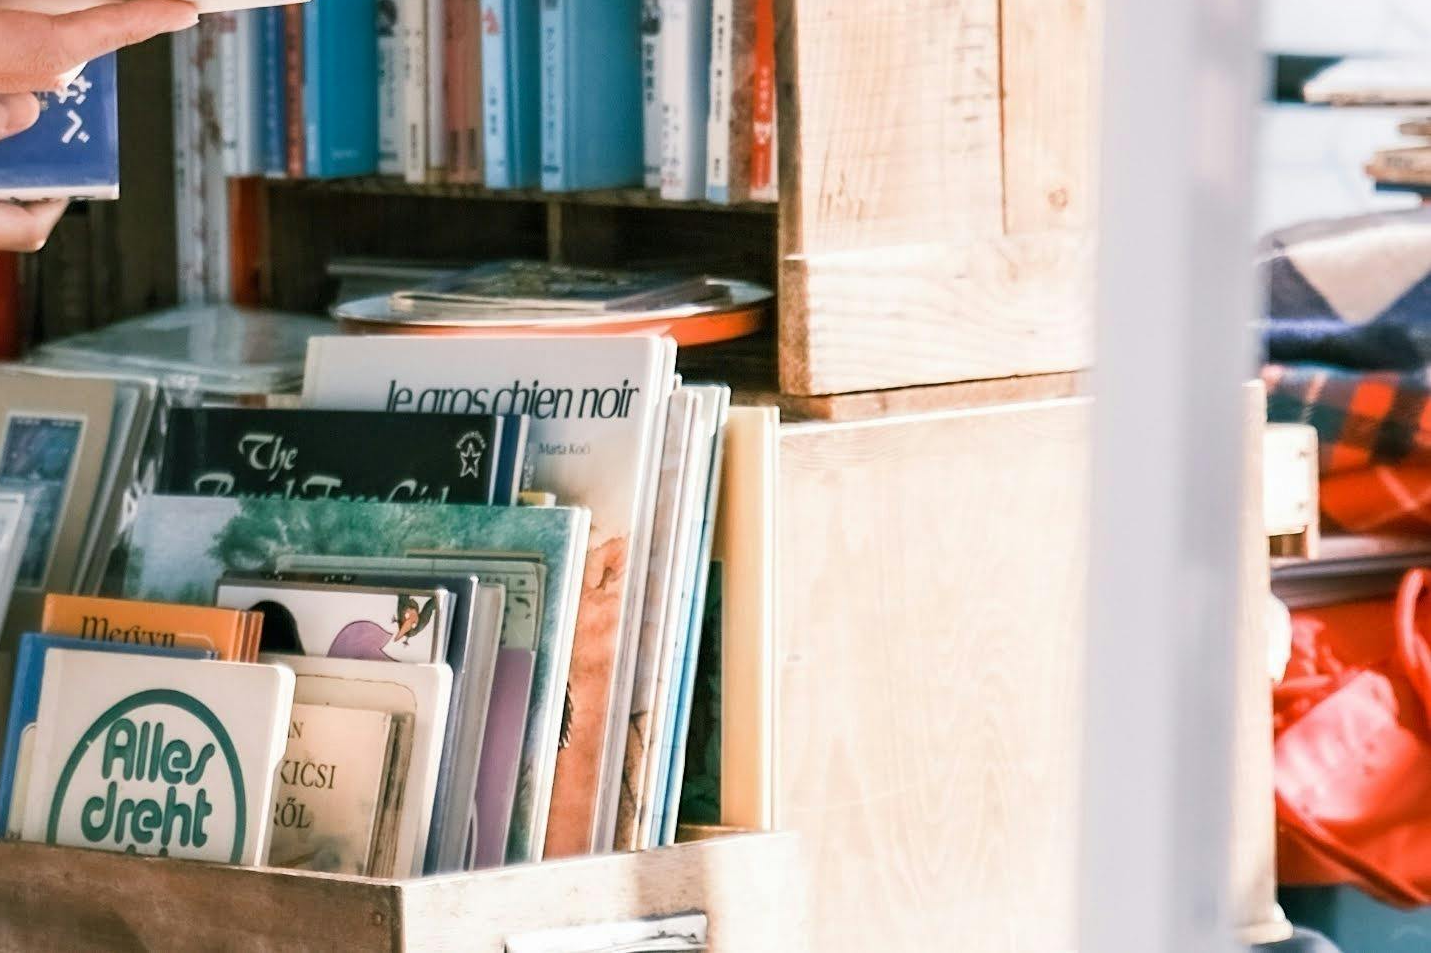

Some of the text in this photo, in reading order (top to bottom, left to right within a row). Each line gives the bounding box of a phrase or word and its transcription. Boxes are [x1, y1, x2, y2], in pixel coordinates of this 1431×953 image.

[386, 379, 413, 413] le
[492, 379, 573, 419] chien
[578, 379, 639, 419] noir
[238, 432, 298, 481] The
[102, 717, 216, 784] Alles
[81, 781, 213, 848] dreht
